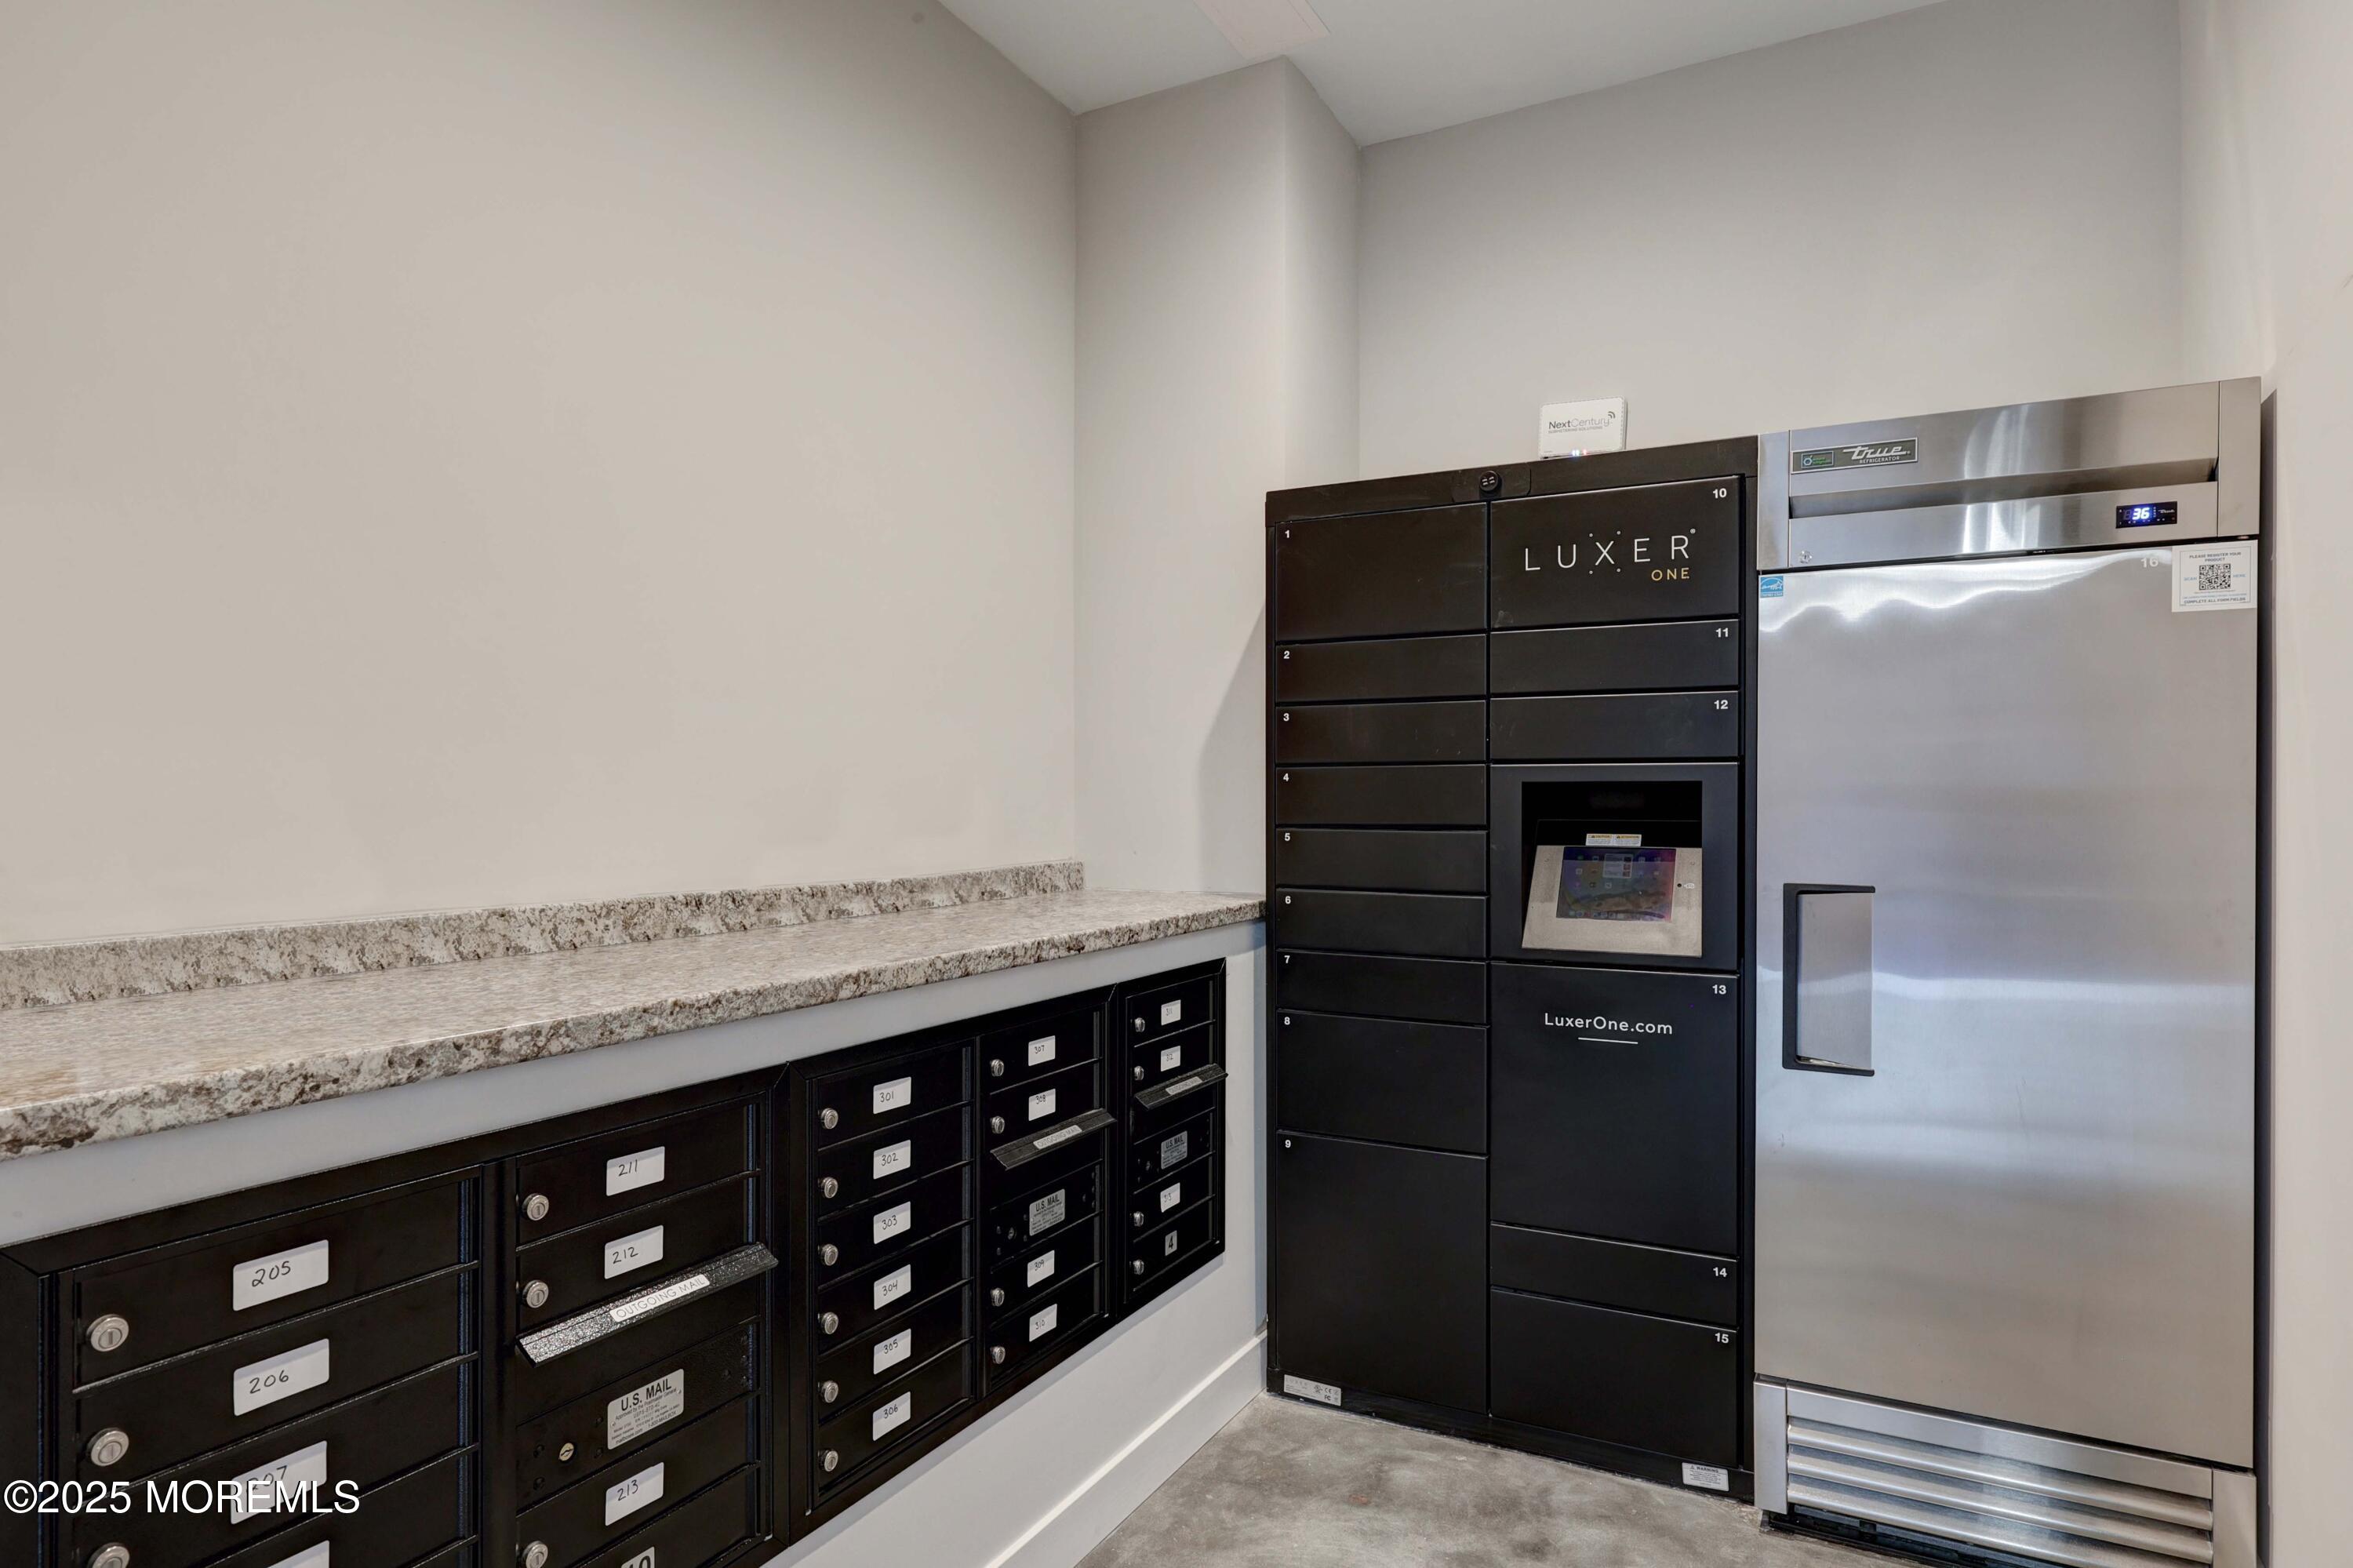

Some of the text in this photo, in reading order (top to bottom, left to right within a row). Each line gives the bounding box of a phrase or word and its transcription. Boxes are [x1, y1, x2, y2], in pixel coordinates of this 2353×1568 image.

[1548, 417, 1610, 430] NextCentury
[1859, 456, 1900, 464] REFRIGERATOR
[1712, 487, 1727, 499] 10
[2132, 507, 2151, 520] 36
[1285, 529, 1290, 539] 1
[2140, 557, 2159, 568] 16
[1651, 567, 1689, 581] ONE
[1715, 627, 1729, 638] 11
[1283, 650, 1290, 660] 2
[1714, 699, 1729, 710] 12
[1283, 712, 1289, 722] 3
[1282, 773, 1289, 782] 4
[1284, 832, 1291, 842] 5
[1285, 895, 1291, 904] 6
[1284, 955, 1290, 964] 7
[1712, 984, 1727, 995] 13
[1284, 1017, 1290, 1025] 8
[1544, 1013, 1673, 1035] LuxerOne.com
[1035, 1045, 1045, 1054] 307
[879, 1090, 894, 1103] 301
[1035, 1094, 1046, 1105] 308
[1285, 1139, 1291, 1148] 9
[881, 1152, 899, 1166] 302
[618, 1159, 638, 1177] 211
[1035, 1193, 1060, 1213] U.S. MAIL
[881, 1214, 897, 1230] 303
[1168, 1235, 1174, 1250] 4
[613, 1246, 638, 1264] 212
[1034, 1259, 1045, 1271] 309
[251, 1260, 292, 1287] 205
[1713, 1267, 1727, 1278] 14
[882, 1279, 898, 1297] 304
[616, 1277, 705, 1319] OUTGOING MAIL
[1035, 1319, 1046, 1330] 310
[1715, 1333, 1729, 1344] 15
[883, 1338, 899, 1354] 305
[249, 1370, 289, 1395] 206
[621, 1378, 672, 1411] U.S. MAIL
[884, 1403, 899, 1419] 306
[616, 1479, 639, 1501] 213
